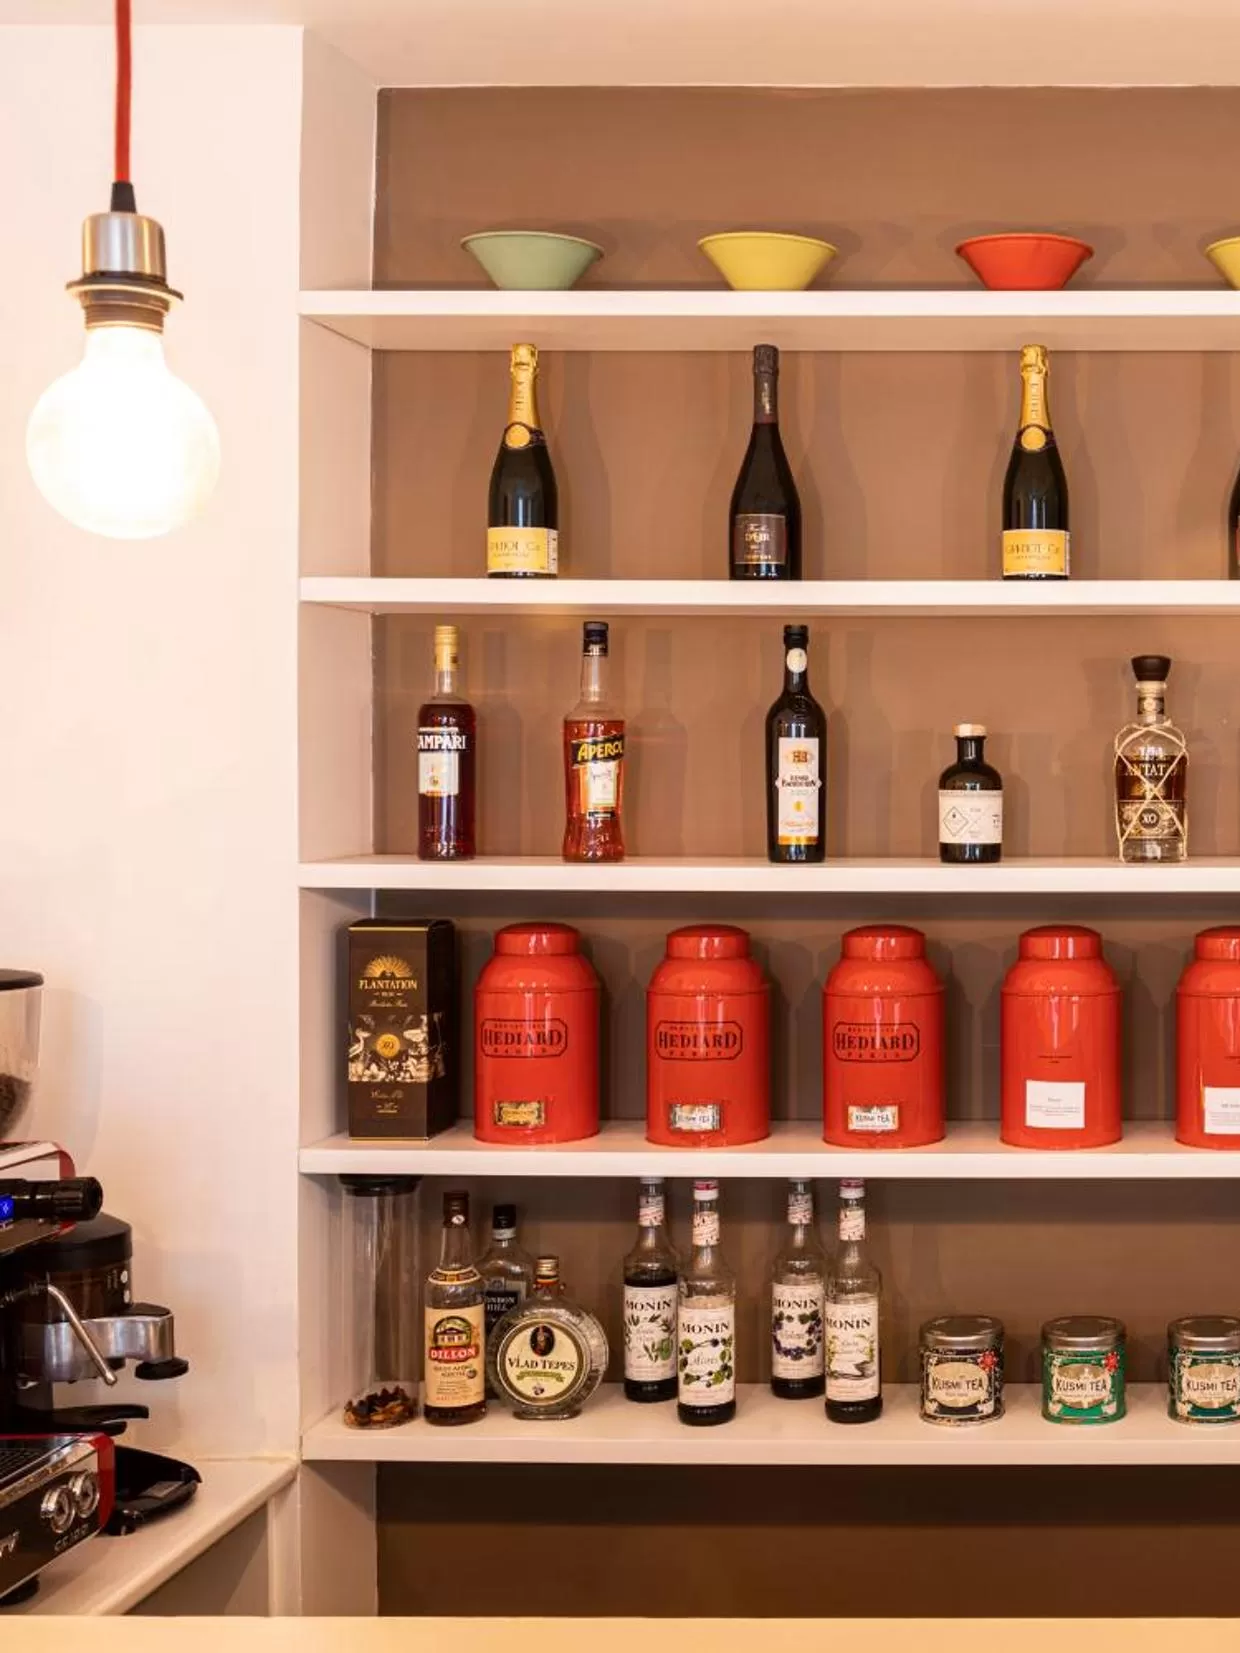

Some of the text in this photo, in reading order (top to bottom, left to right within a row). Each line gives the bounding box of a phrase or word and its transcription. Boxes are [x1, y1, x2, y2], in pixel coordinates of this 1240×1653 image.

[417, 735, 467, 750] AMPARI
[577, 742, 623, 761] APERO
[1141, 811, 1157, 824] XO
[358, 979, 418, 990] PLANTATION
[483, 1029, 562, 1046] HEDIARD
[659, 1031, 738, 1049] HEDIARD
[835, 1032, 915, 1050] HEDIARD
[625, 1299, 672, 1312] MONIN
[682, 1321, 730, 1335] MONIN
[826, 1317, 871, 1331] MONIN
[430, 1345, 476, 1361] DILLON
[508, 1356, 540, 1370] VLAD
[965, 1377, 985, 1391] TEA
[1055, 1378, 1107, 1392] KUSMI TEA
[1186, 1378, 1238, 1392] KUSMI TEA
